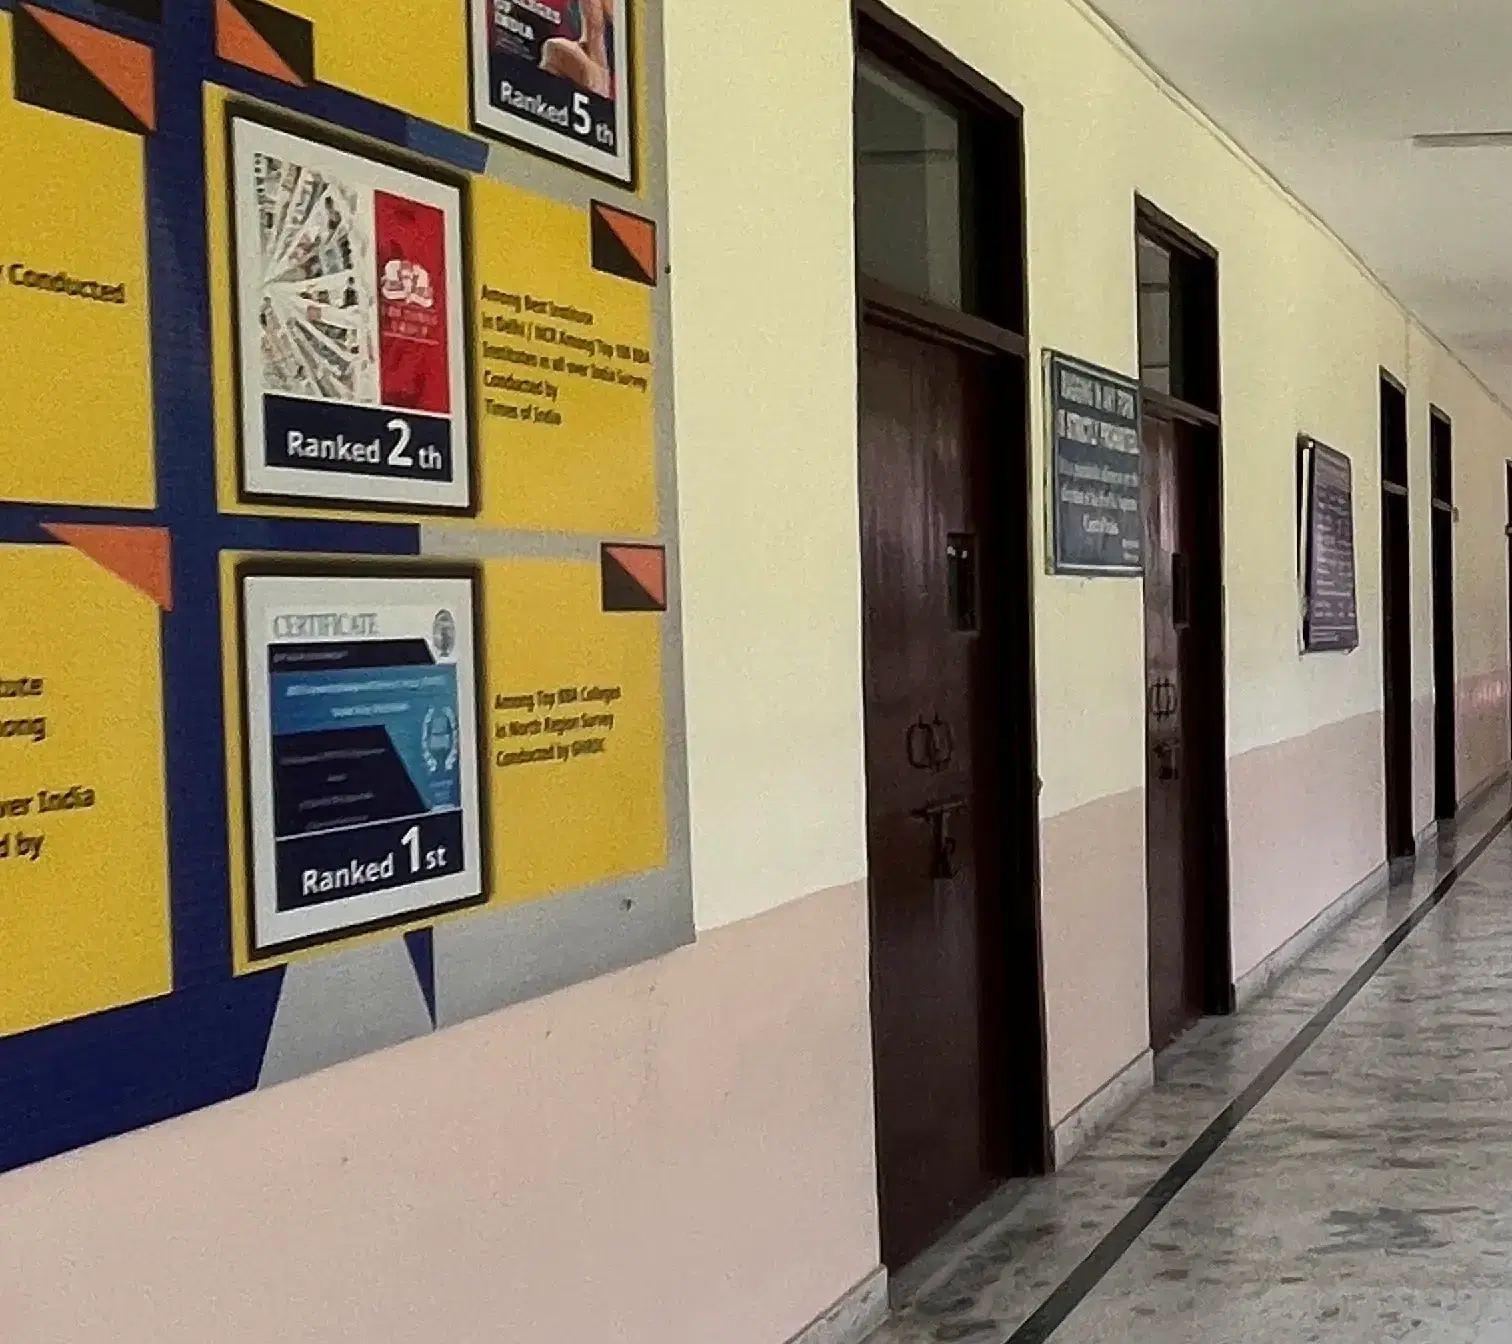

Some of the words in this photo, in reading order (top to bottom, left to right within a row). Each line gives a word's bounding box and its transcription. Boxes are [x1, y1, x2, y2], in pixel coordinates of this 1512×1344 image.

[500, 80, 569, 127] Ranked
[8, 263, 125, 304] Conducted
[286, 430, 381, 464] Ranked
[37, 785, 95, 813] India
[15, 831, 45, 861] by
[302, 852, 394, 896] Ranked
